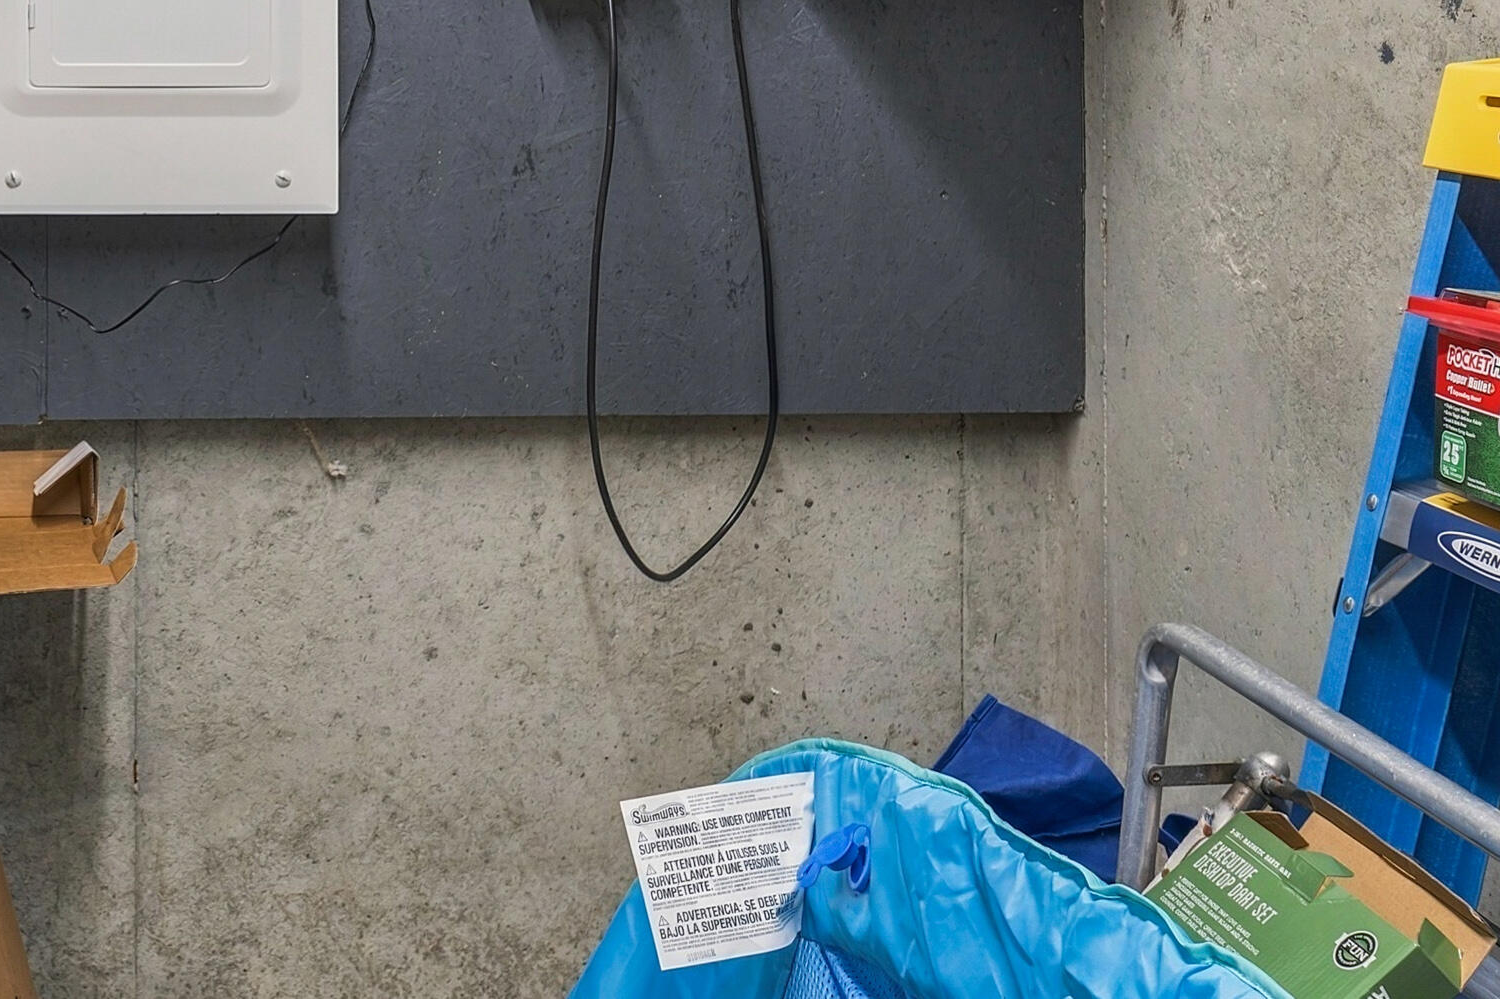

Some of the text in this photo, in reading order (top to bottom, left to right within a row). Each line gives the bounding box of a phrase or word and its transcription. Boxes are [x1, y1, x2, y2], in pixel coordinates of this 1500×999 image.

[1447, 345, 1491, 374] POCKET
[1468, 376, 1492, 395] Bullet
[1443, 440, 1460, 465] 25
[654, 821, 701, 839] WARNING:
[702, 818, 718, 831] USE
[719, 815, 744, 828] UNDER
[745, 806, 792, 824] COMPETENT
[639, 835, 701, 856] SUPERVISION.
[663, 853, 716, 873] ATTENTION!
[725, 846, 759, 861] UTILISER
[758, 842, 779, 856] SOUS
[779, 840, 790, 852] LA
[647, 867, 715, 889] SURVEILLANCE
[715, 861, 744, 876] D'UNE
[743, 855, 781, 871] PERSONNE
[1207, 841, 1258, 883] EXECUTIVE
[1193, 854, 1278, 924] DESKTOP DART SET
[676, 902, 743, 923] ADVERTENCIA:
[744, 899, 757, 912] SE
[757, 894, 779, 909] DEBE
[659, 925, 685, 940] BAJO
[686, 922, 701, 935] LA
[763, 908, 777, 921] DE
[1342, 939, 1369, 962] FUN
